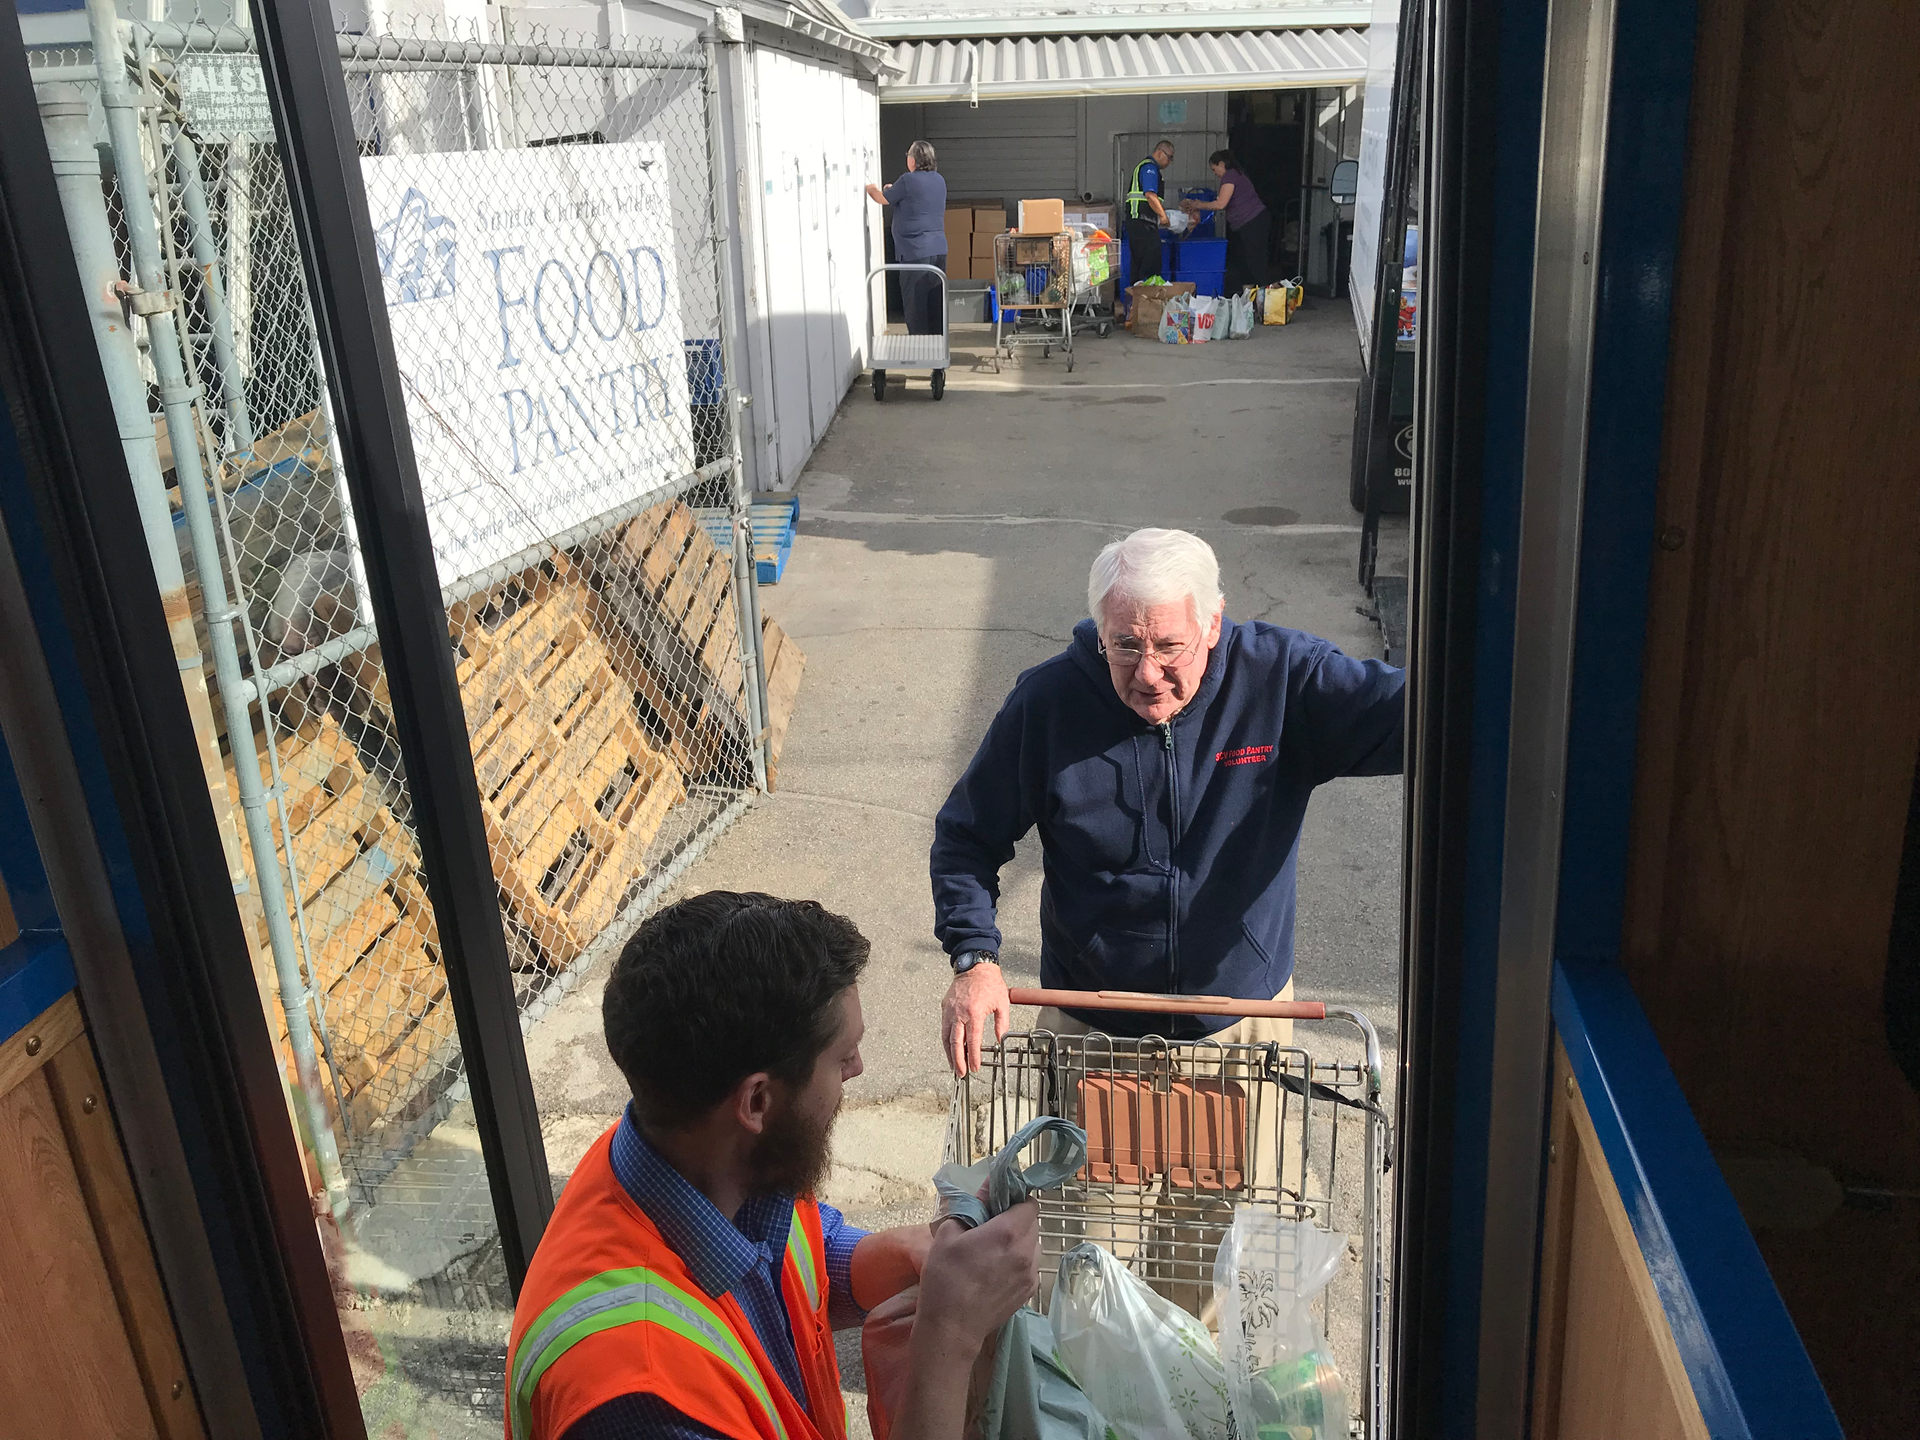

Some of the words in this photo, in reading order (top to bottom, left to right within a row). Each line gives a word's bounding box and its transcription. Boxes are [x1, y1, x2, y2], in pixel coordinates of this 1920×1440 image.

[190, 67, 238, 92] ALL
[476, 200, 535, 232] Santa
[544, 193, 606, 223] Clarita
[483, 245, 667, 369] FOOD
[498, 353, 673, 475] PANTRY
[472, 520, 503, 543] Santa
[547, 489, 577, 511] Valley
[1224, 755, 1267, 767] VOLUNTEER
